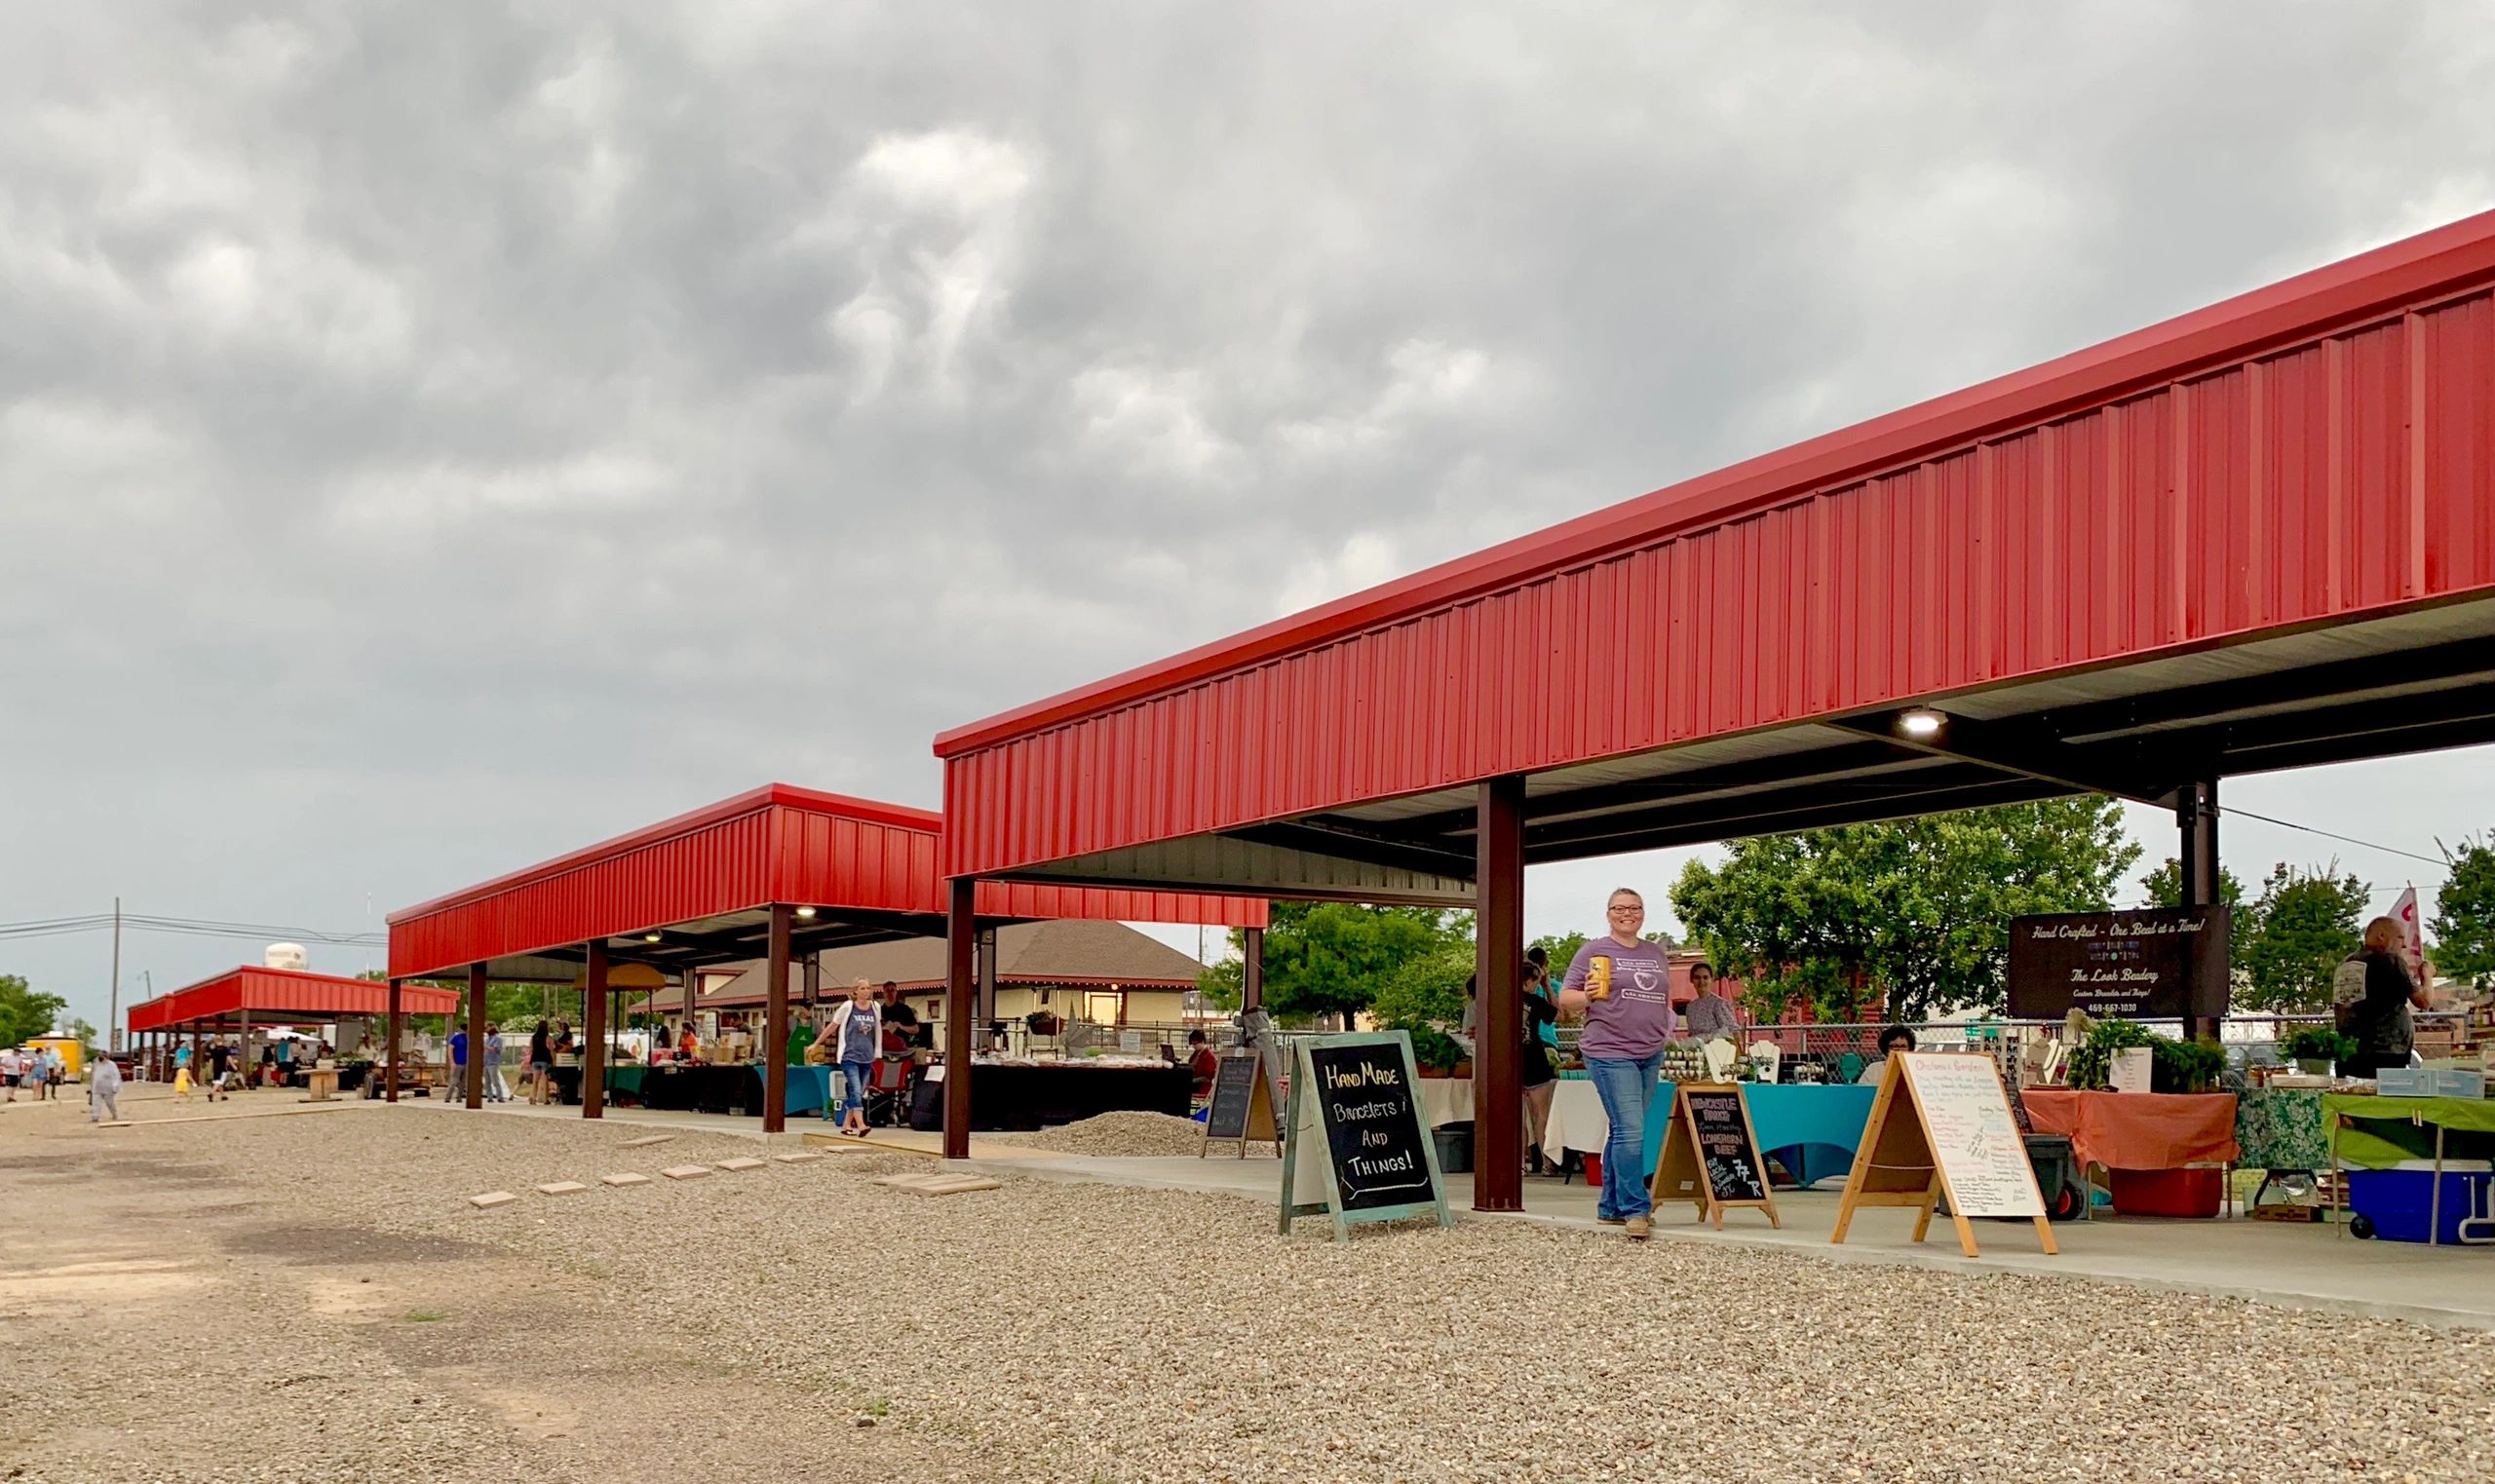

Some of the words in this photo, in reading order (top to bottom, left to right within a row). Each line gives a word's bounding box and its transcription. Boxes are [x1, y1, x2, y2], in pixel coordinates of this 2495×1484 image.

[2031, 925, 2057, 938] Hand
[2059, 924, 2097, 940] Crafted
[2109, 922, 2129, 936] One
[2130, 921, 2158, 935] Bead
[2157, 923, 2168, 933] at
[2168, 925, 2175, 933] a
[2176, 918, 2207, 932] Time!
[2070, 969, 2089, 982] The
[1362, 1129, 1389, 1148] AND
[1701, 1133, 1743, 1145] LONGHORN
[1714, 1144, 1737, 1155] BEEF
[1347, 1149, 1414, 1177] THINGS!
